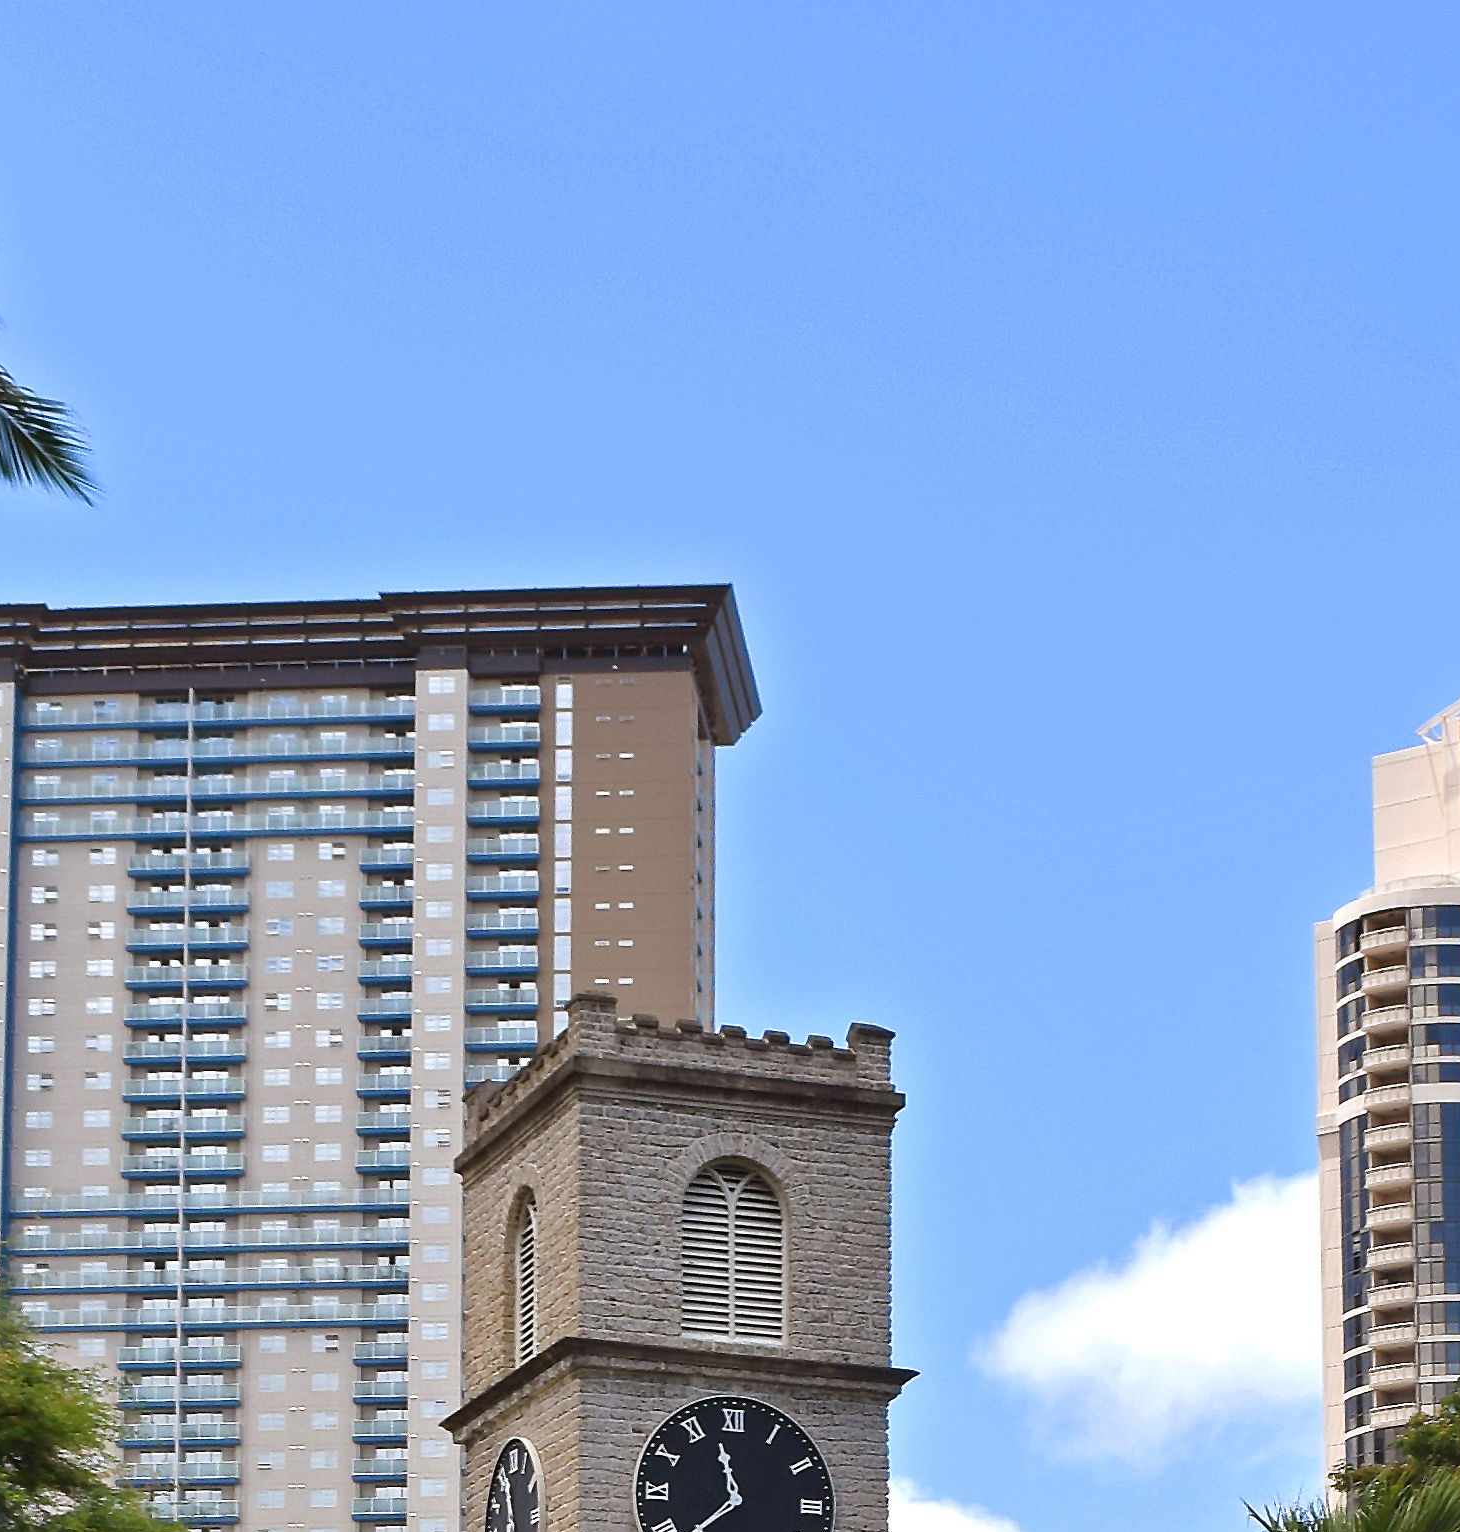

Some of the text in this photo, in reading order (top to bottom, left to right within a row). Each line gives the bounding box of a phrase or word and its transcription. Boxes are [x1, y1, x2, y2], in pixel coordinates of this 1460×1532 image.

[680, 1416, 706, 1443] XI
[722, 1408, 745, 1432] XII
[765, 1423, 781, 1444] I
[654, 1443, 681, 1467] X
[789, 1457, 813, 1475] II
[645, 1481, 669, 1500] IX
[800, 1498, 823, 1515] III
